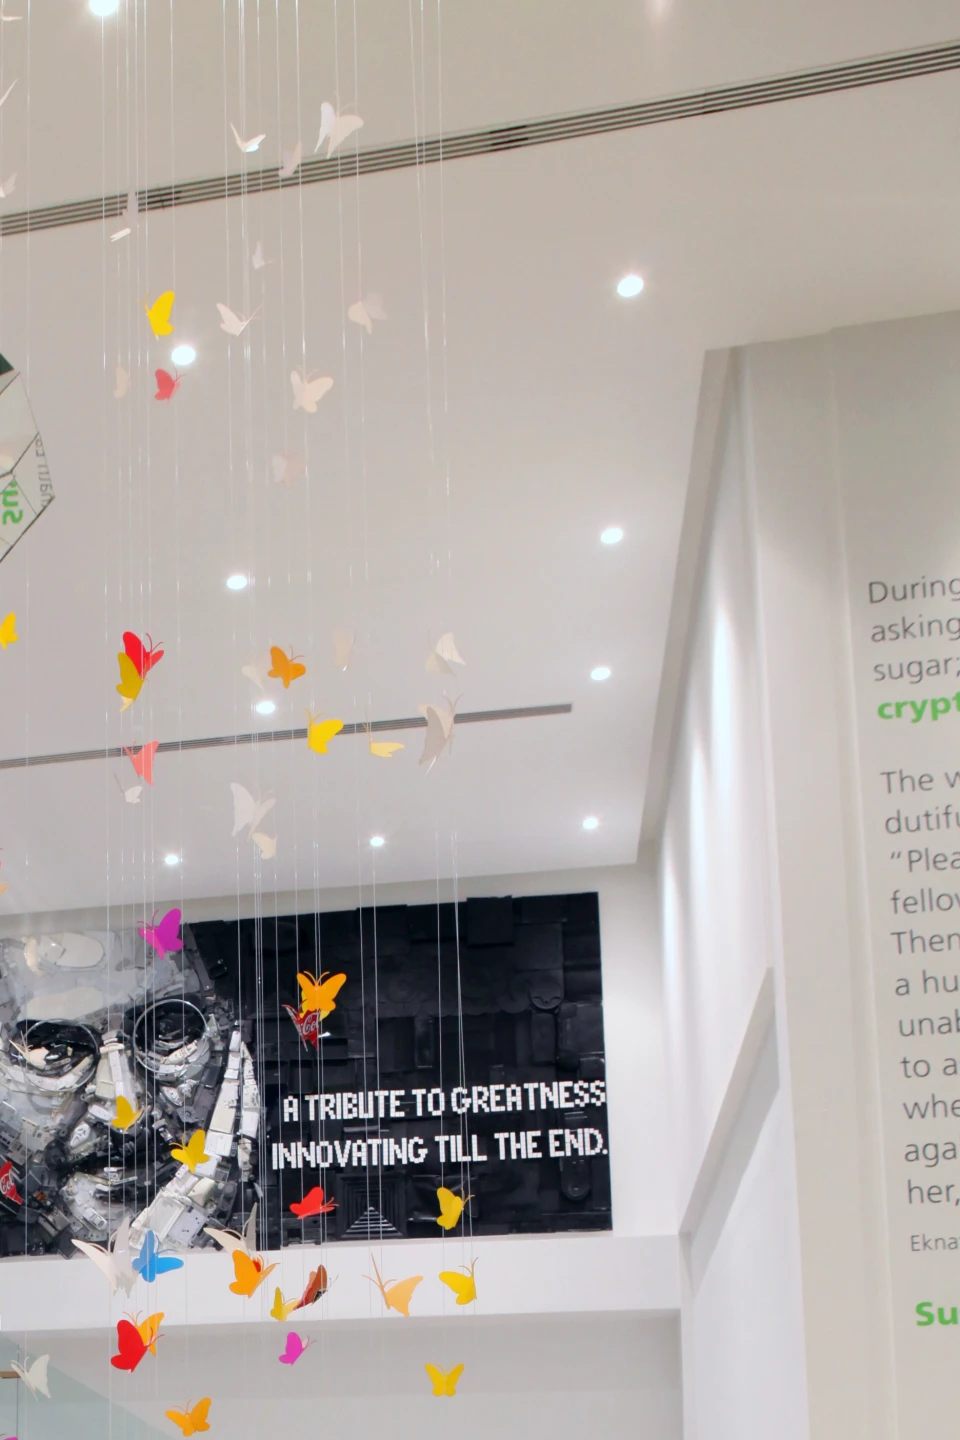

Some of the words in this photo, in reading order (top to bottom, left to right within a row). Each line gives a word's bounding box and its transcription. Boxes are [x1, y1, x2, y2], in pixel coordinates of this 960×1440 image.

[868, 575, 960, 604] During
[871, 614, 960, 643] asking
[873, 656, 960, 684] sugar;
[880, 769, 934, 794] The
[885, 804, 960, 834] dutif
[890, 887, 960, 915] fello
[890, 929, 960, 955] Then
[895, 978, 910, 996] a
[922, 969, 959, 994] hu
[900, 1056, 930, 1079] to
[283, 1096, 298, 1122] A
[305, 1090, 405, 1121] TRIBUTE
[412, 1088, 445, 1116] TO
[451, 1080, 606, 1114] GREATNESS
[272, 1136, 428, 1170] INNOVATING
[435, 1134, 487, 1163] TILL
[494, 1131, 541, 1160] THE
[549, 1128, 608, 1157] END.
